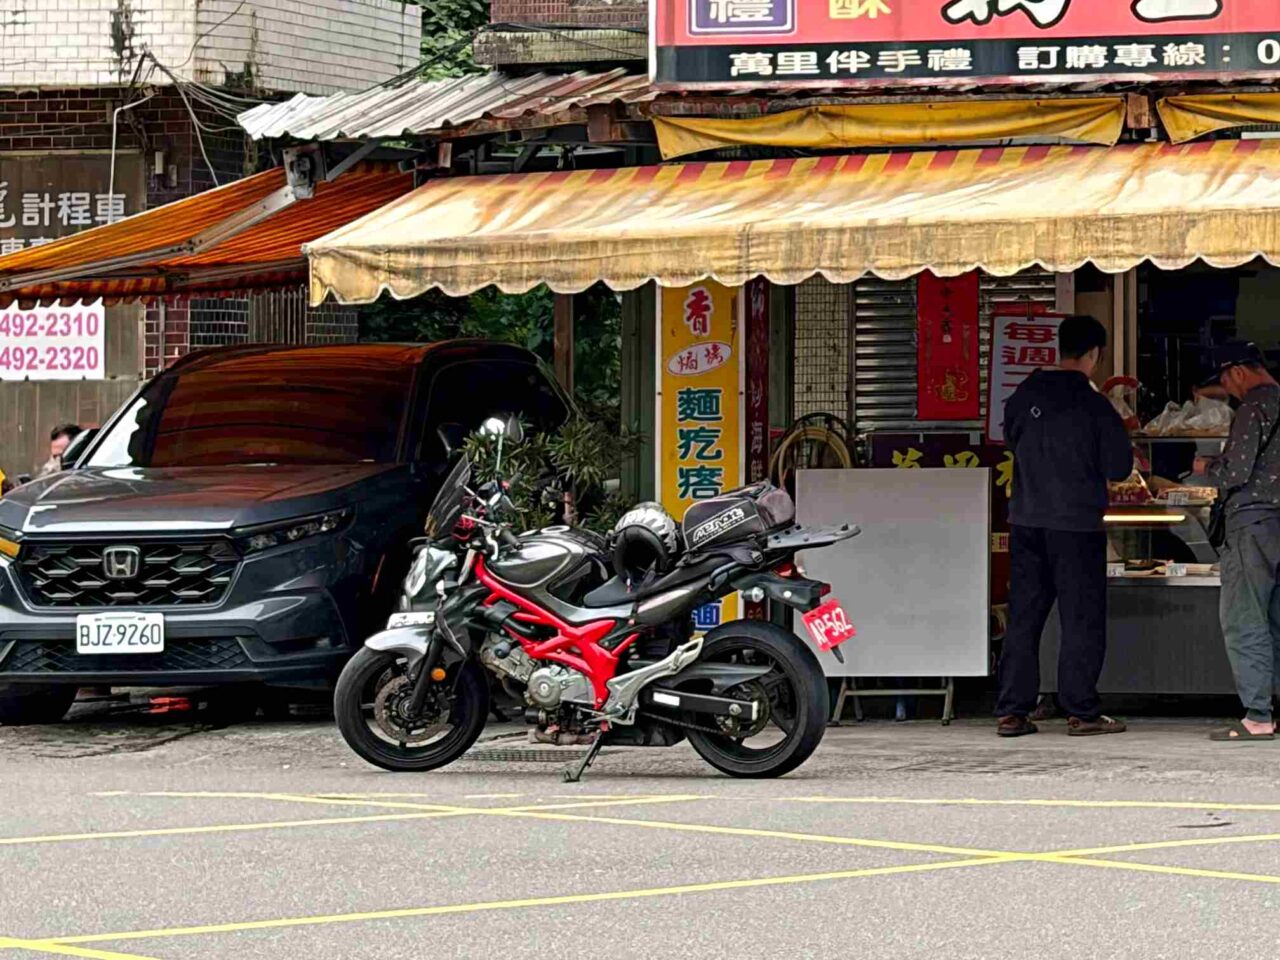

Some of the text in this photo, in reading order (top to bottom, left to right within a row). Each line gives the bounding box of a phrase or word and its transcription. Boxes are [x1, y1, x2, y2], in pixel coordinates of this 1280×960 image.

[729, 48, 974, 76] 萬里伴手禮
[677, 386, 723, 500] 麵疙瘩
